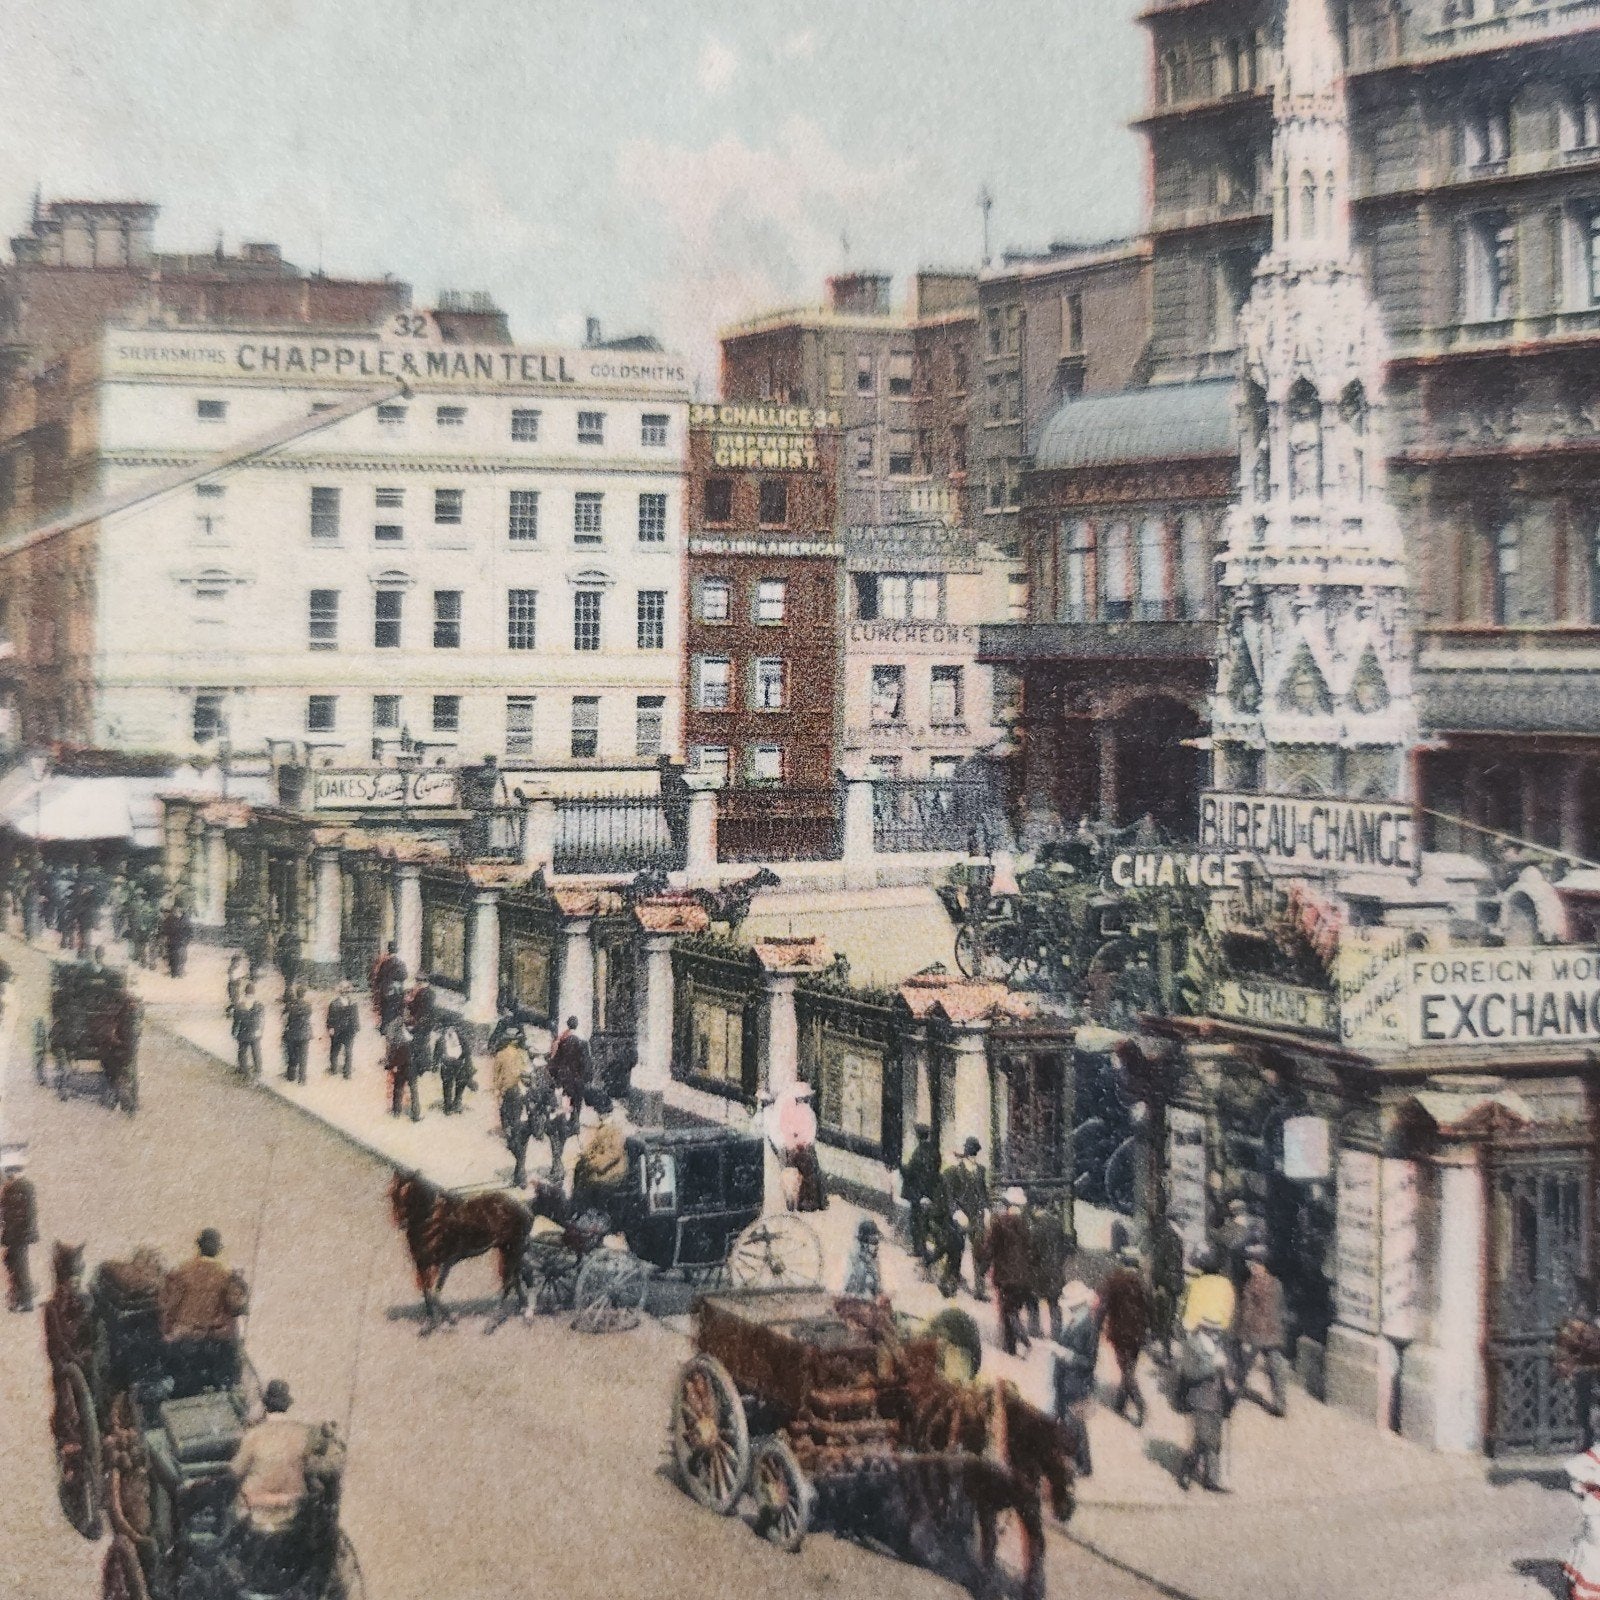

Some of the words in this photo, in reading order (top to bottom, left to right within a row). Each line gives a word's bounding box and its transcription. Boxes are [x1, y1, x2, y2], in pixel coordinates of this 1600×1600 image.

[394, 314, 428, 339] 32
[119, 345, 226, 364] SILVERSMITHS
[236, 344, 396, 376] CHAPPLE
[401, 352, 422, 378] &
[426, 351, 576, 383] MANTELL
[590, 364, 686, 382] GOLDSMITHS
[718, 406, 812, 427] CHALLICE
[813, 410, 842, 428] 34
[850, 625, 974, 643] LUNCHEONS
[318, 778, 367, 798] OAKES
[1202, 797, 1297, 857] BUREAU
[1310, 806, 1412, 868] CHANGE
[1111, 853, 1243, 888] CHANGE
[1412, 960, 1533, 984] FOREIGN
